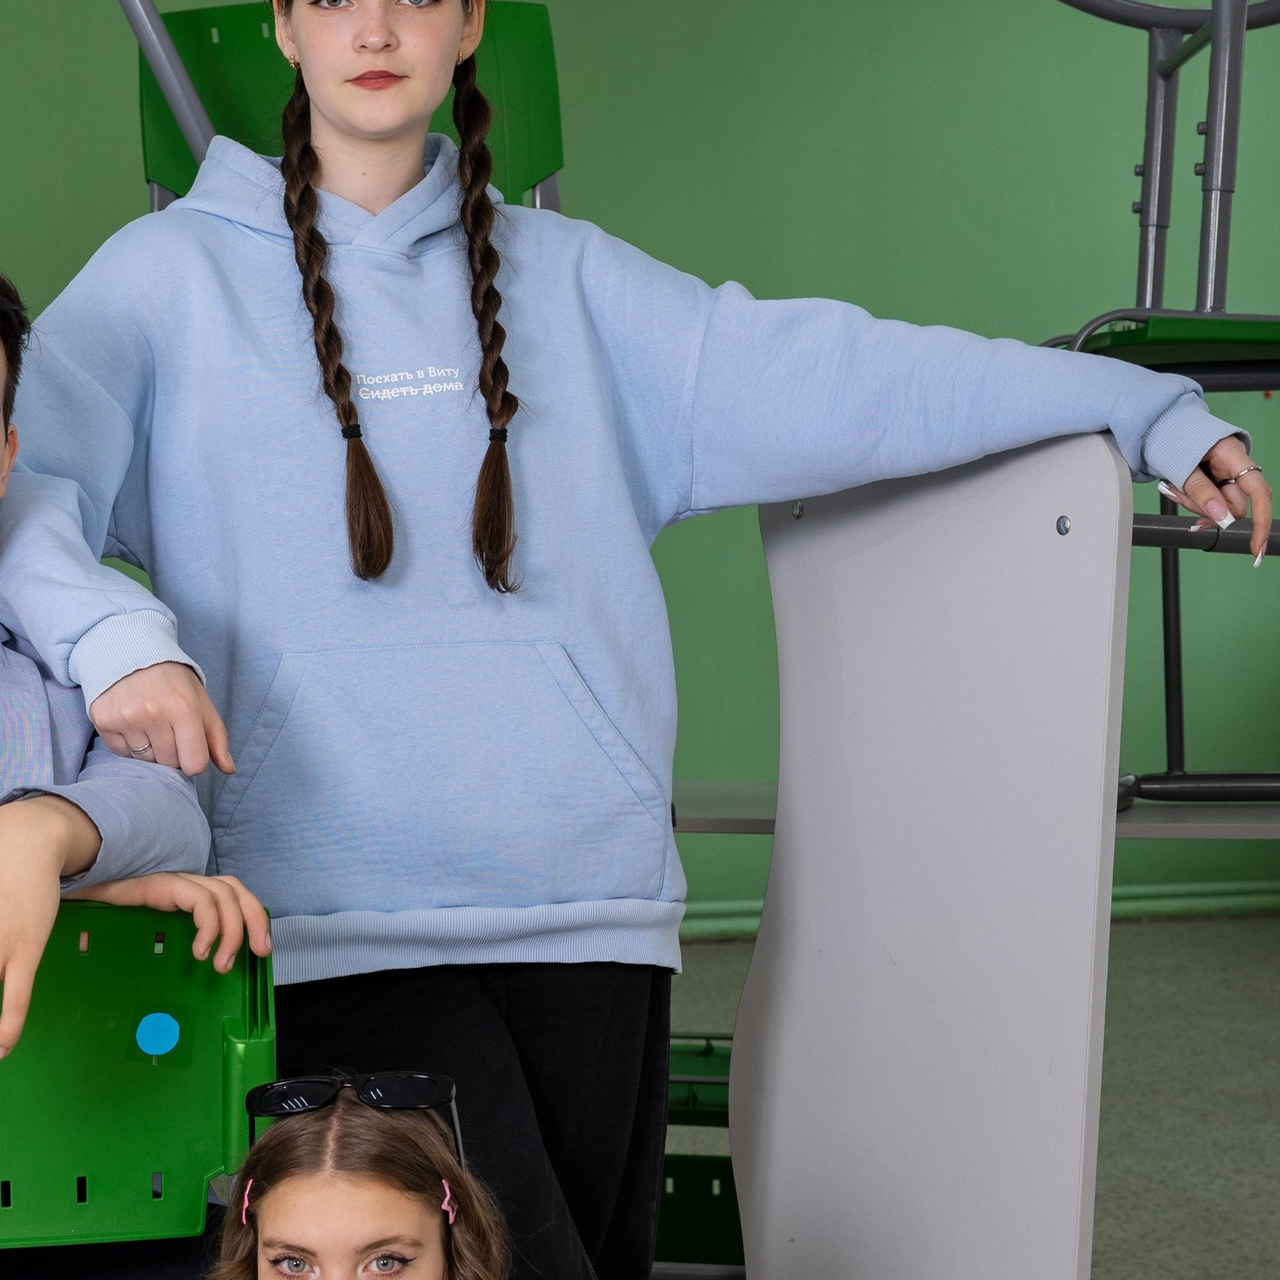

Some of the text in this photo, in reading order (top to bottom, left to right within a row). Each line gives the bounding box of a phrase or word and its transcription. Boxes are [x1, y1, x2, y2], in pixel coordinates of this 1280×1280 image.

[355, 366, 460, 385] Поехать в Виту
[358, 381, 464, 400] Сидеть дома
